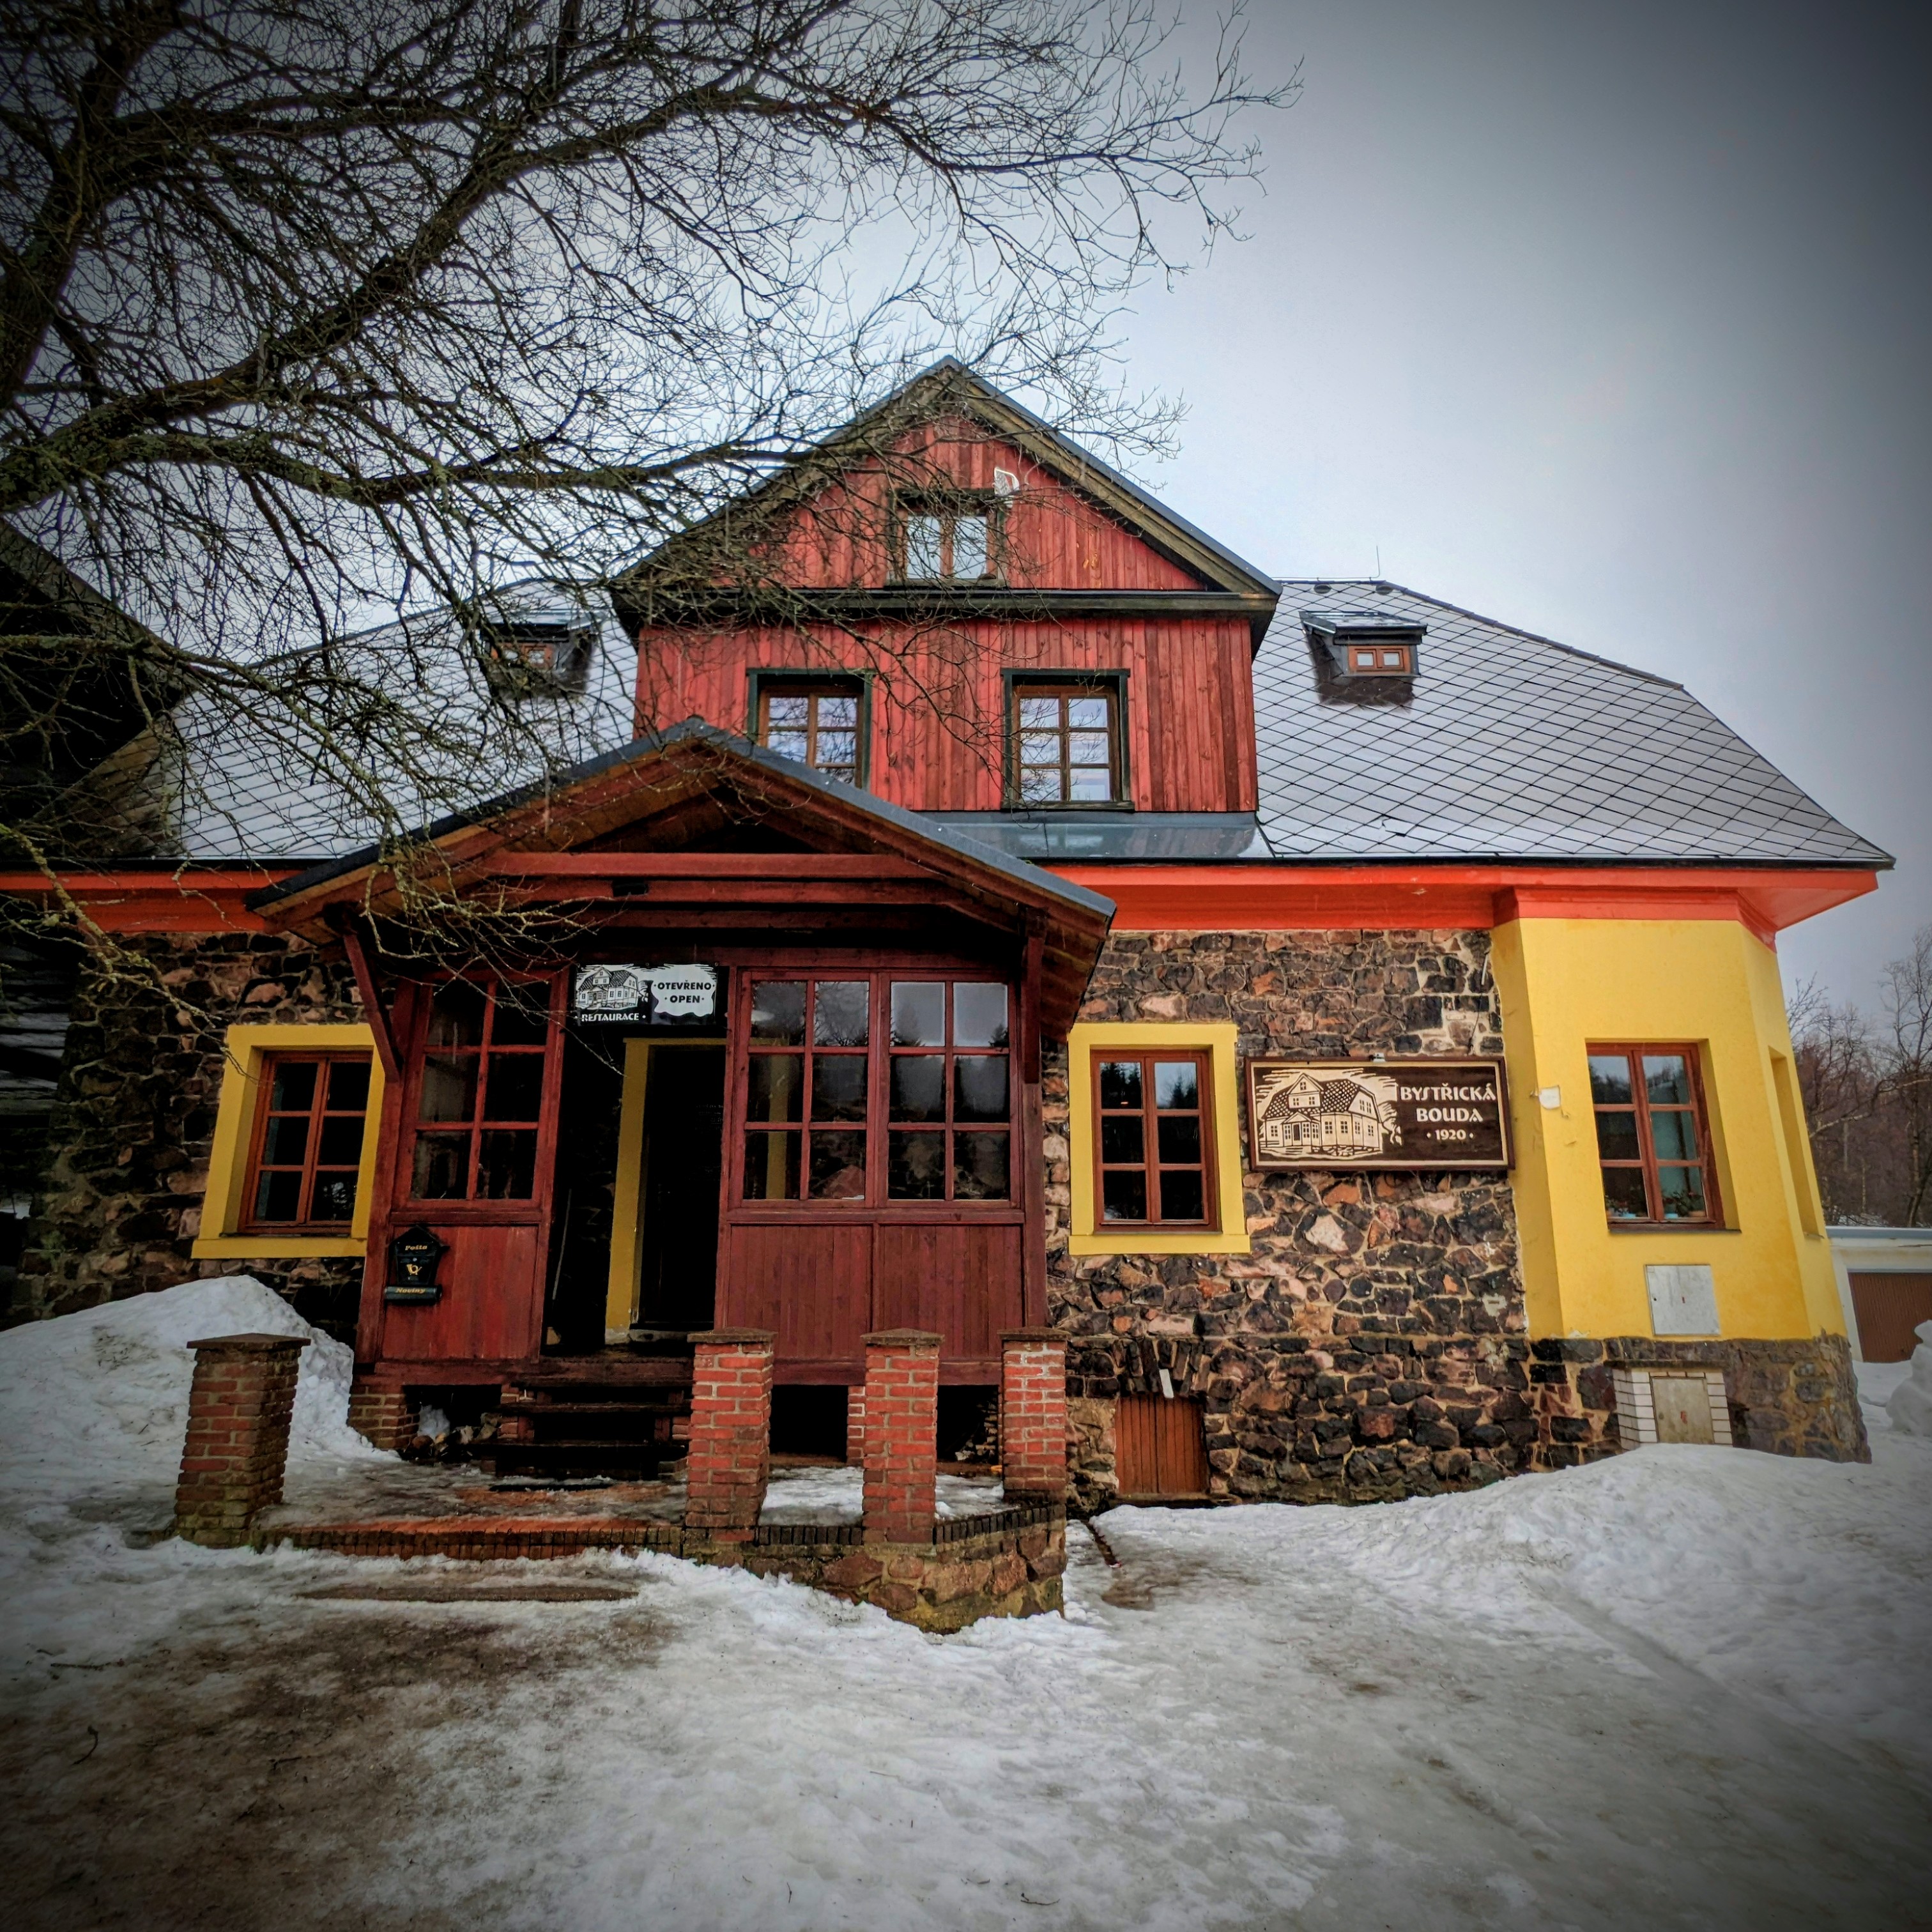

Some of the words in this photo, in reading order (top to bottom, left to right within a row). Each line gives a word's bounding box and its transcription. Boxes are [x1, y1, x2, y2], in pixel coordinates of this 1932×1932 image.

[657, 979, 712, 990] OTEVŘENO
[670, 995, 700, 1004] OPEN
[581, 1013, 640, 1022] RESTAURACE
[1400, 1082, 1496, 1101] BYSTŘICKÁ
[1416, 1107, 1483, 1123] BOUDA
[1435, 1129, 1467, 1140] 1920
